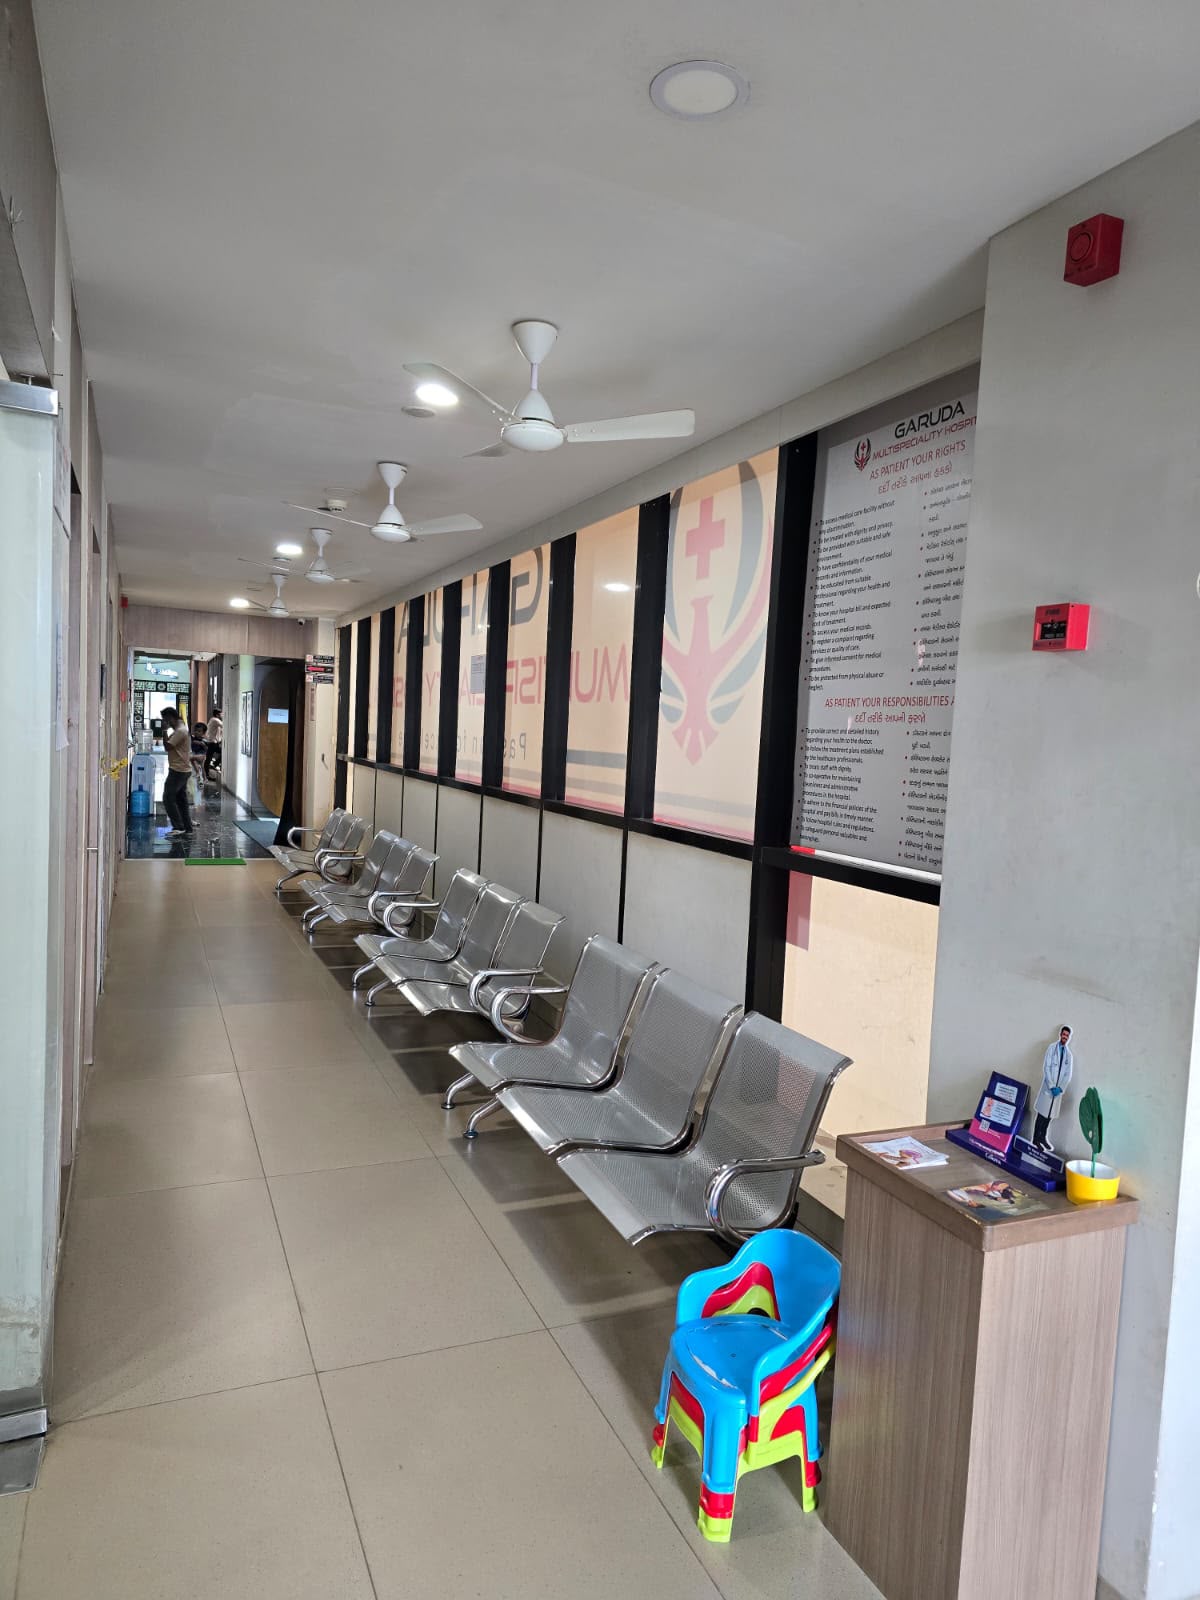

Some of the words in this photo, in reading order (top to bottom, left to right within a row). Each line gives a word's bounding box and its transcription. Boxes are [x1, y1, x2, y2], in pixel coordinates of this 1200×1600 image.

[894, 401, 965, 439] GARUDA
[869, 470, 880, 481] AS
[880, 458, 909, 477] PATIENT
[911, 450, 933, 466] YOUR
[935, 440, 966, 459] RIGHTS
[872, 429, 943, 461] MULTISPECIALITY
[824, 698, 834, 708] AS
[834, 698, 861, 707] PATIENT
[862, 697, 881, 707] YOUR
[882, 696, 949, 706] RESPONSIBILITIES
